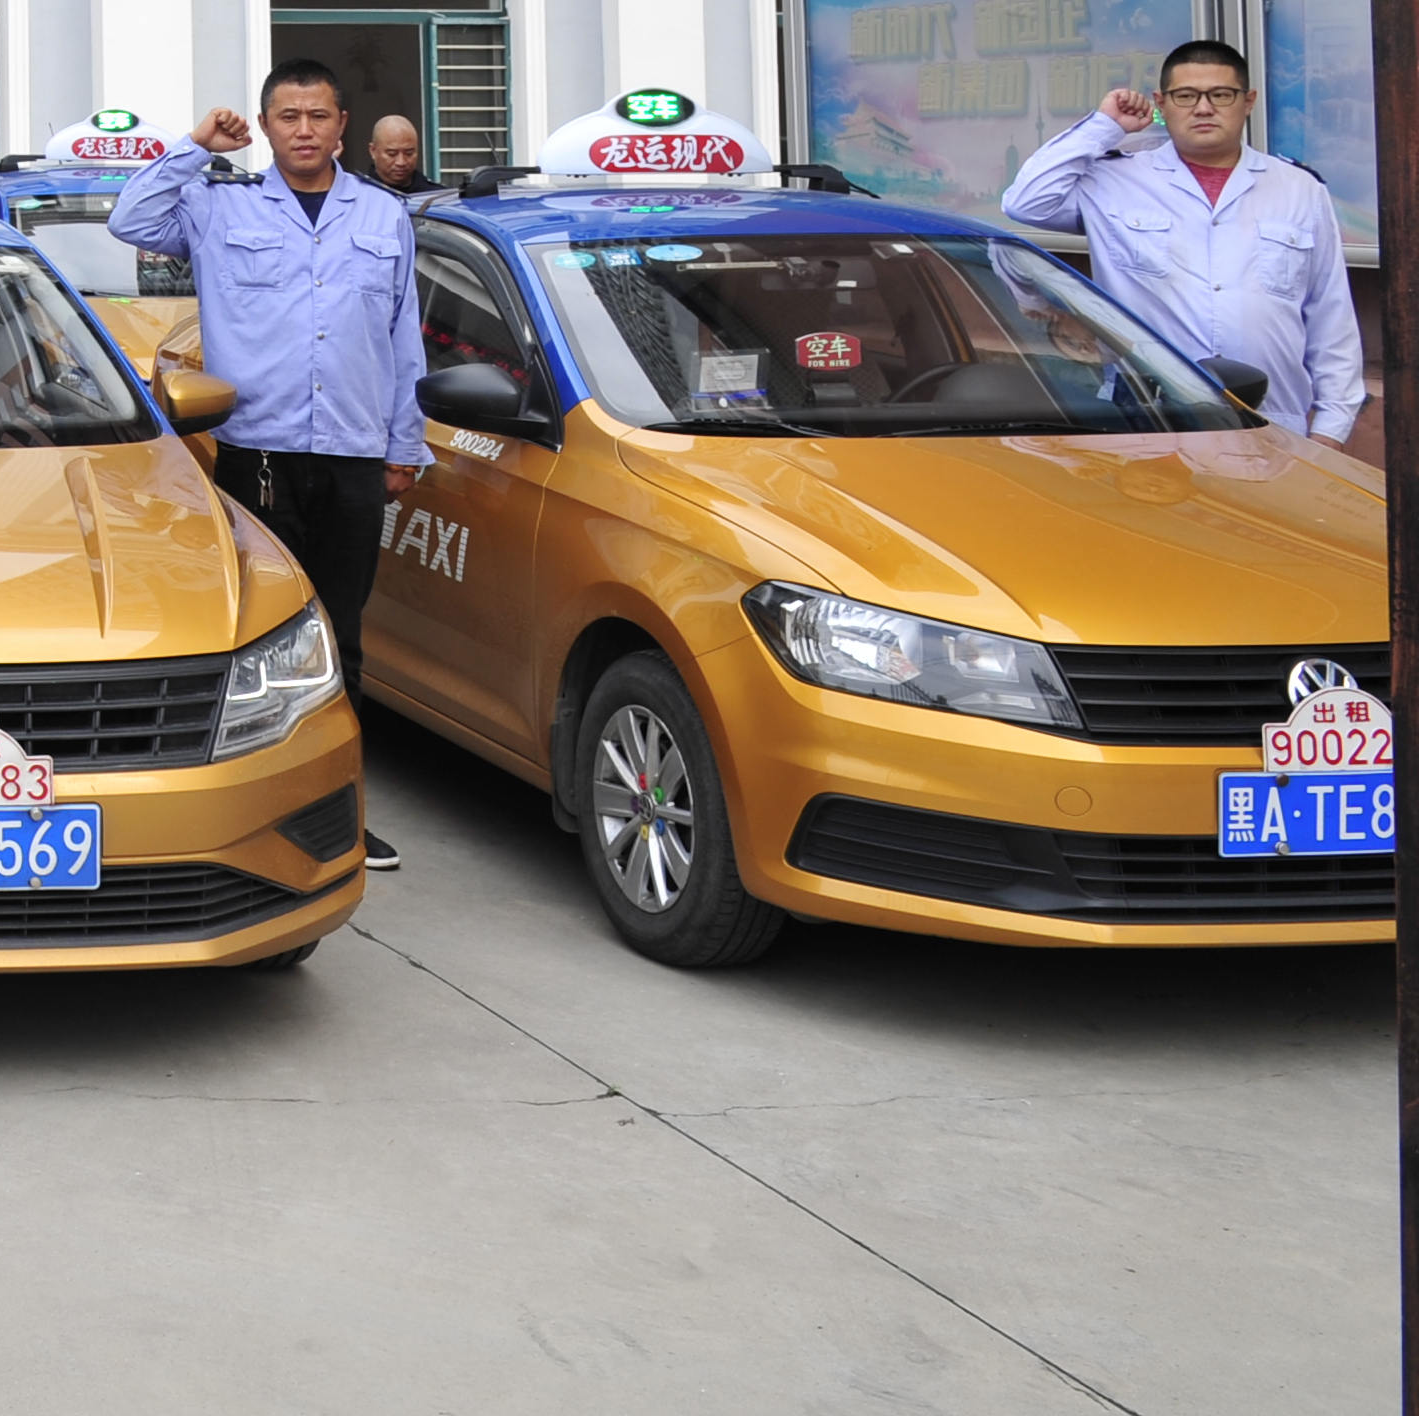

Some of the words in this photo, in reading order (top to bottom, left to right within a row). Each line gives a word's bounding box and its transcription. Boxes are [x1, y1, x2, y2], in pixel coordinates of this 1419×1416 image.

[850, 1, 956, 64] 新时代
[917, 57, 1030, 120] 新集团
[627, 95, 679, 119] 空车
[77, 137, 159, 159] 龙运现代
[599, 135, 735, 171] 龙运现代
[805, 335, 852, 359] 空车
[807, 359, 825, 368] FOR
[829, 359, 851, 368] HIRE
[449, 428, 505, 462] 900224
[1313, 701, 1370, 723] 出租
[1271, 728, 1393, 766] 90022
